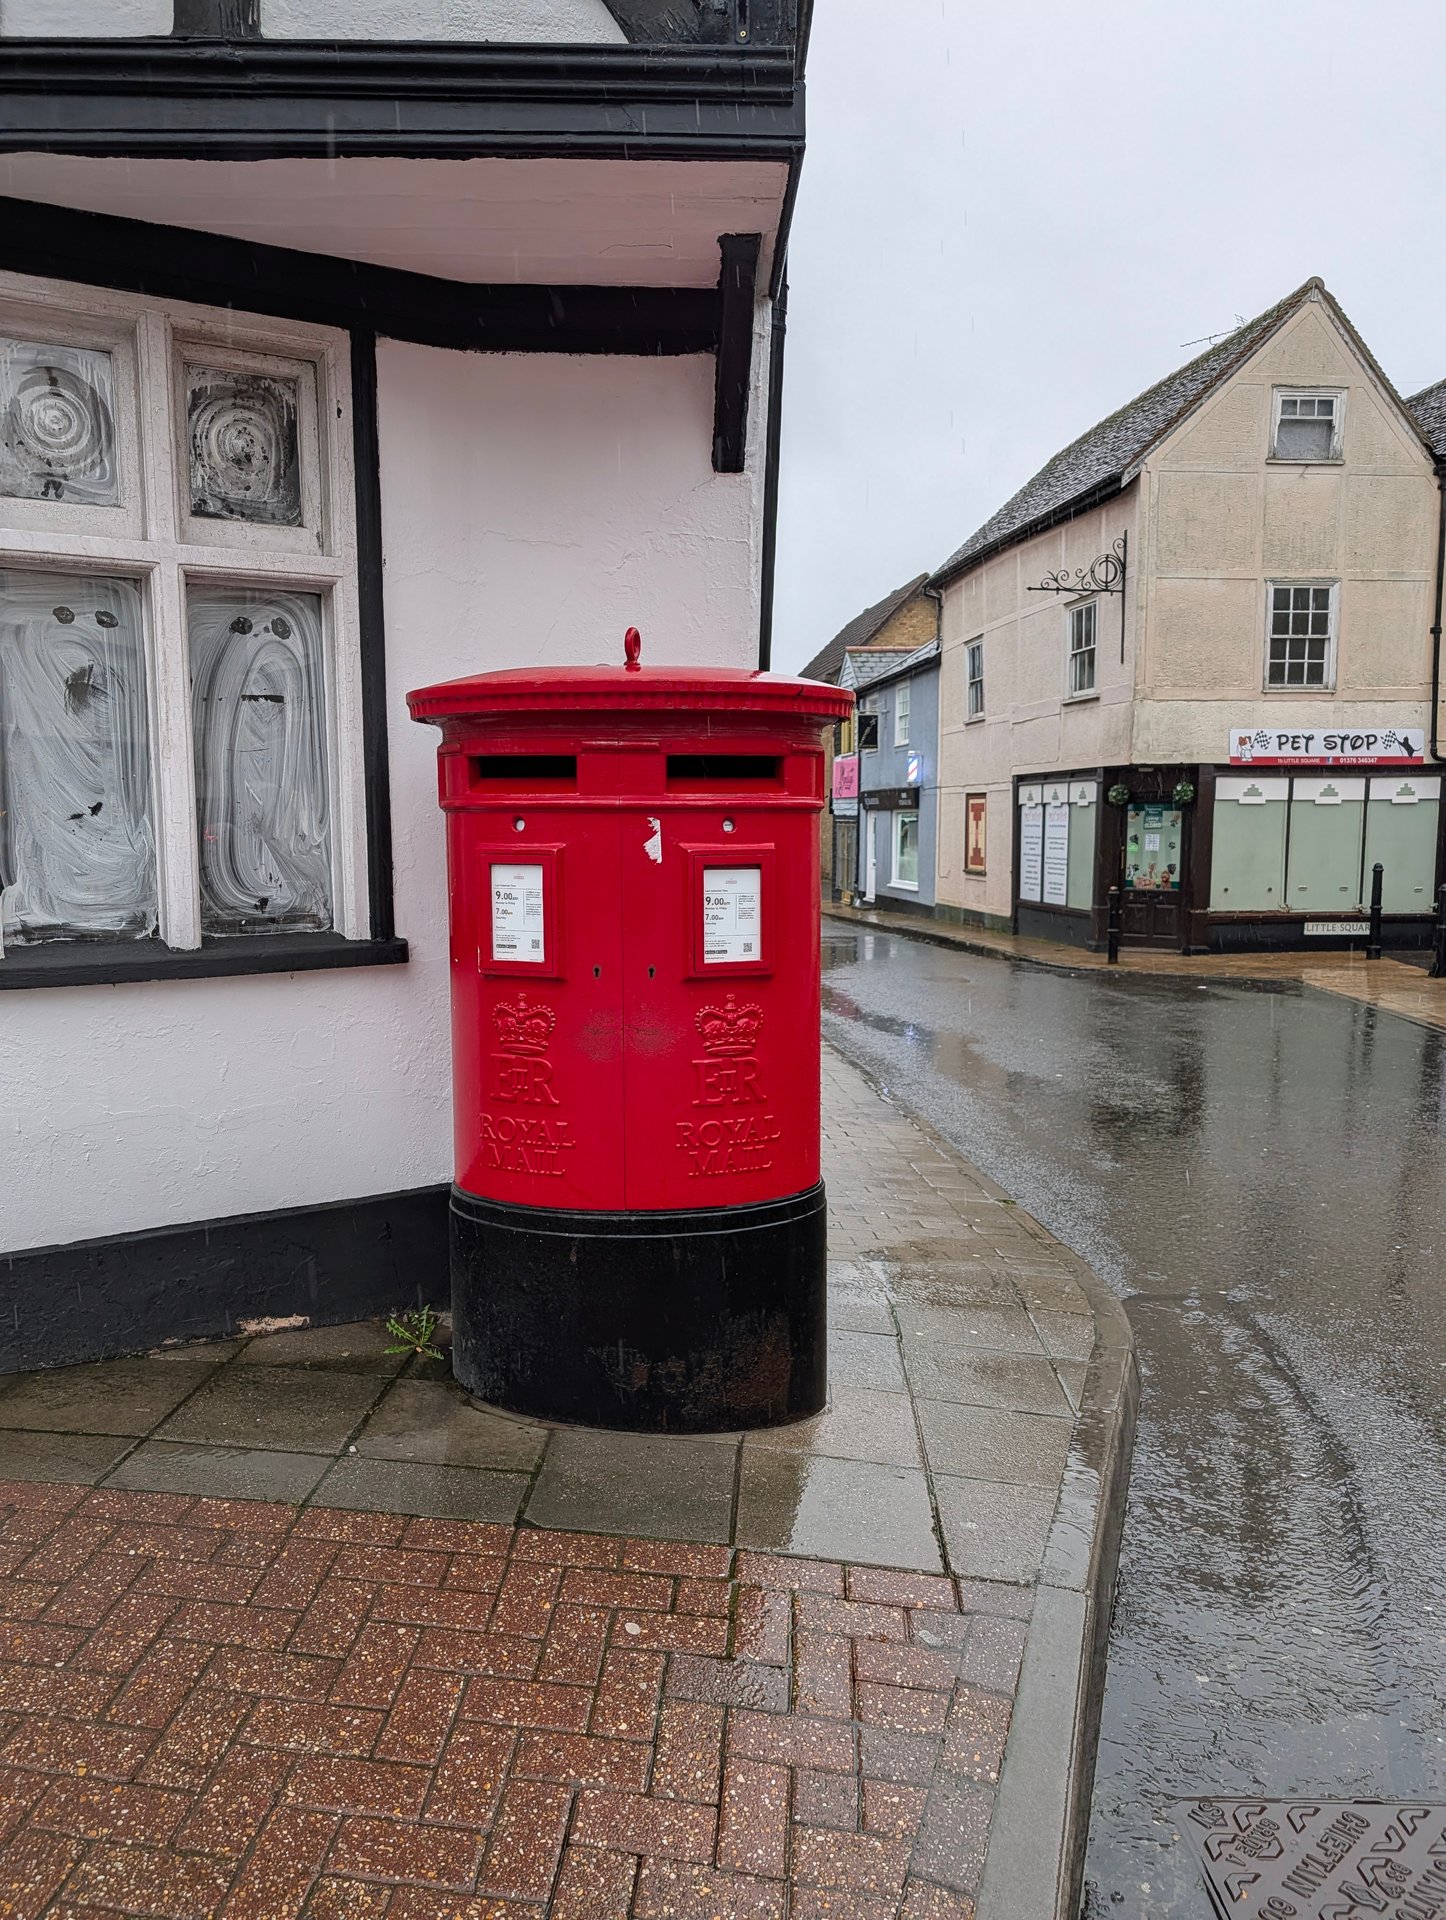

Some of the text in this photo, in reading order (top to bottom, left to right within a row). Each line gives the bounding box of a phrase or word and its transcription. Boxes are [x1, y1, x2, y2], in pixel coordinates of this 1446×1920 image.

[1276, 733, 1378, 754] PET STOP
[1306, 923, 1371, 933] LITTLE SQUAR
[479, 1112, 576, 1149] ROYAL
[675, 1115, 782, 1148] ROYAL
[479, 1143, 567, 1177] MAIL
[687, 1145, 773, 1177] MAIL
[1281, 1810, 1371, 1899] CHIEFTAIN
